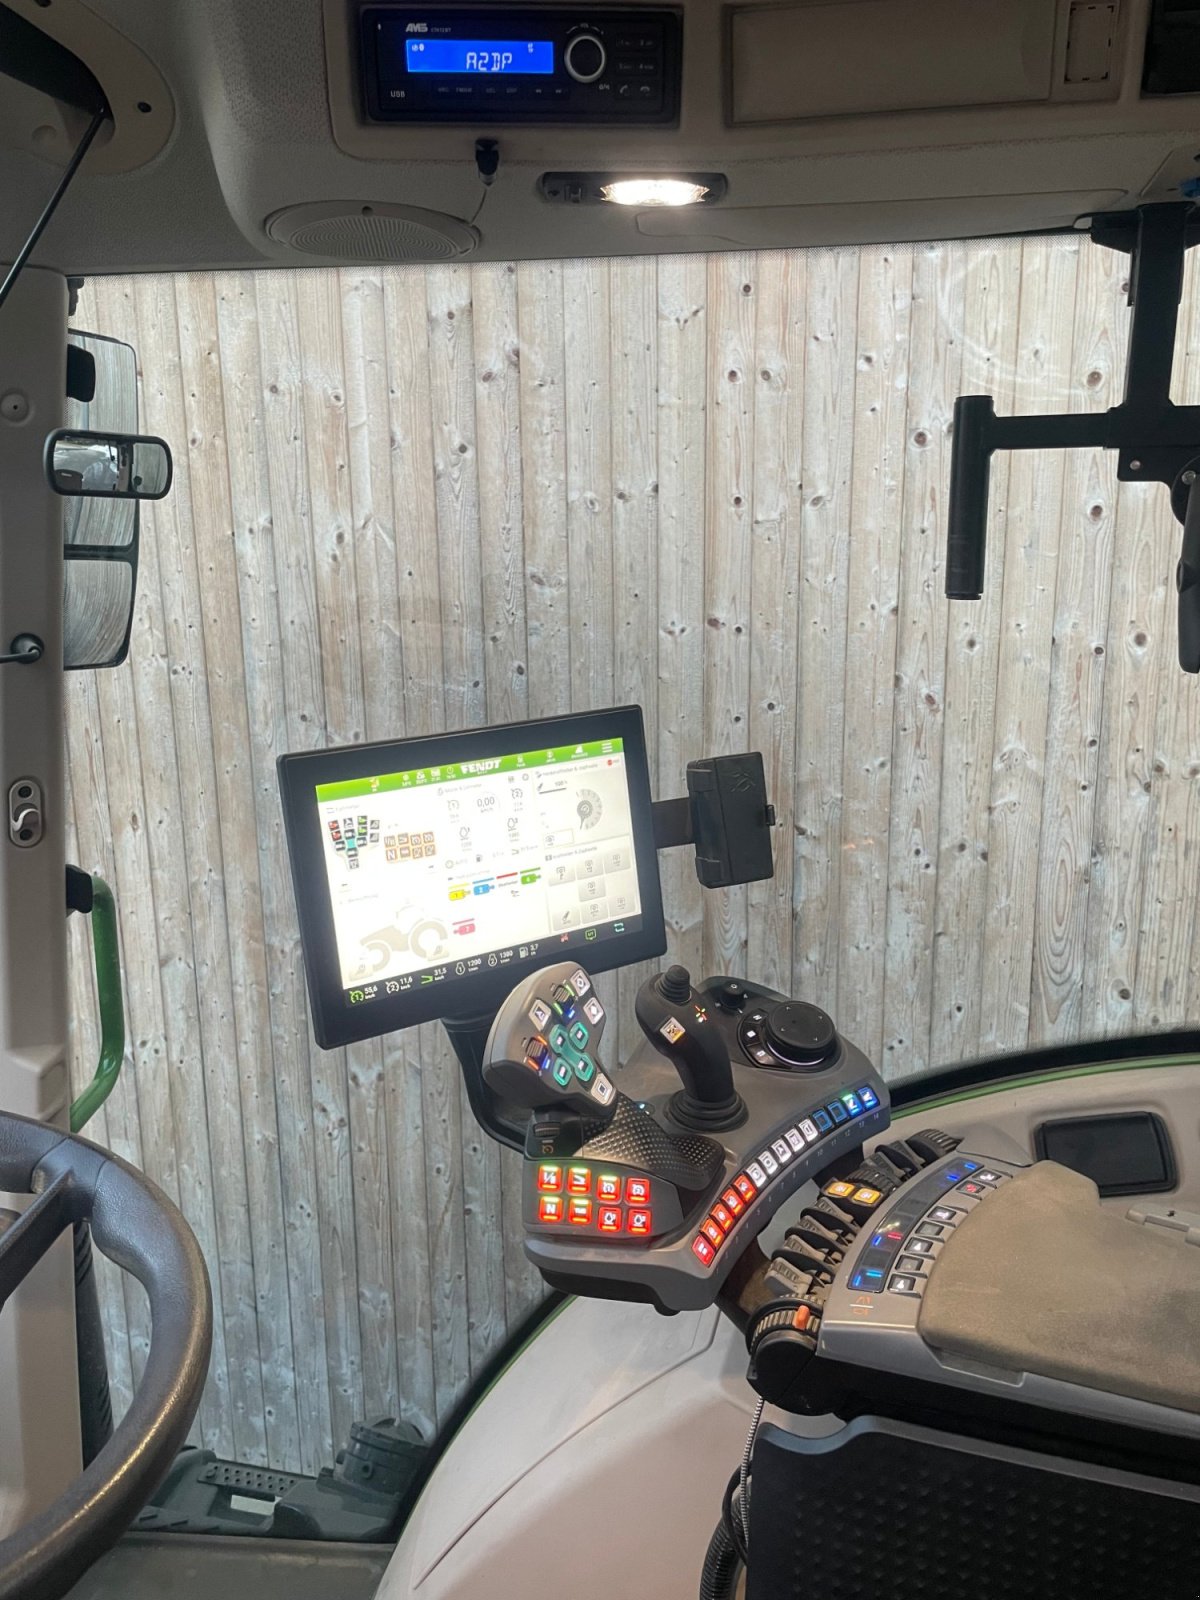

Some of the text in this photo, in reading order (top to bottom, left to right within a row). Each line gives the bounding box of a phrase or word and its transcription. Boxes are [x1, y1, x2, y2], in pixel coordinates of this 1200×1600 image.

[405, 22, 428, 32] AMS
[466, 52, 513, 72] A2DP
[390, 90, 406, 98] USB
[460, 759, 502, 775] FENDT
[477, 796, 495, 808] 0,00
[467, 958, 482, 967] 1200
[433, 967, 447, 976] 31,5
[399, 976, 413, 985] 11,6
[364, 985, 378, 995] 55,6
[546, 1203, 556, 1214] N
